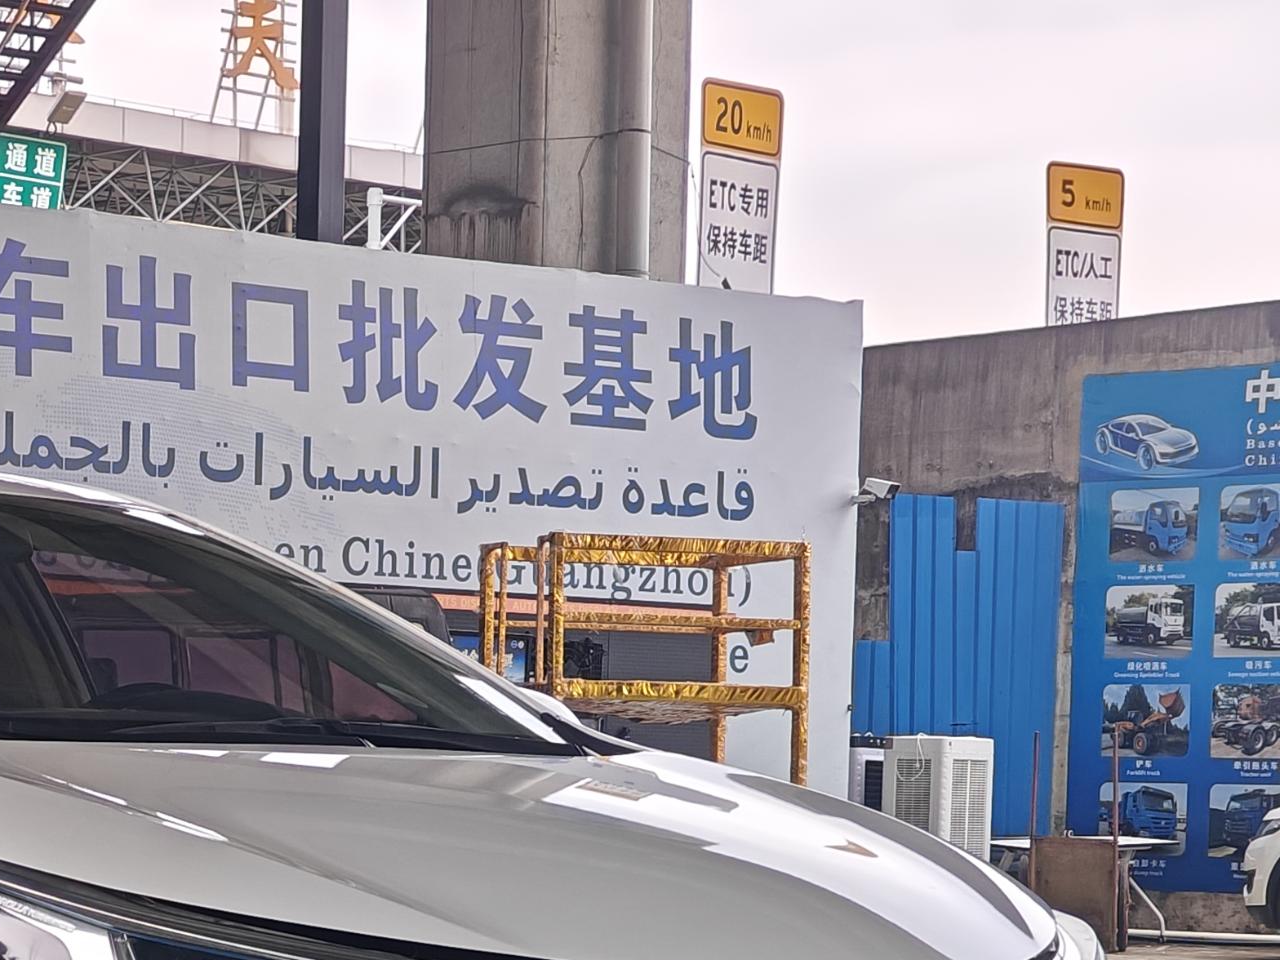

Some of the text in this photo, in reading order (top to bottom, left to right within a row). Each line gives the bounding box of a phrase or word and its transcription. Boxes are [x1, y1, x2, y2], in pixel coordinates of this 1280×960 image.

[715, 97, 772, 144] 20 km/h
[709, 178, 769, 219] ETC专用
[1061, 179, 1112, 213] 5 km/h
[706, 223, 768, 265] 保持车距
[1055, 249, 1112, 279] ETC/人工
[1054, 295, 1112, 325] 保持车距
[1246, 439, 1280, 450] Bas
[200, 431, 439, 500] السيارات
[457, 467, 603, 514] تصدير
[622, 467, 754, 521] قاعدة
